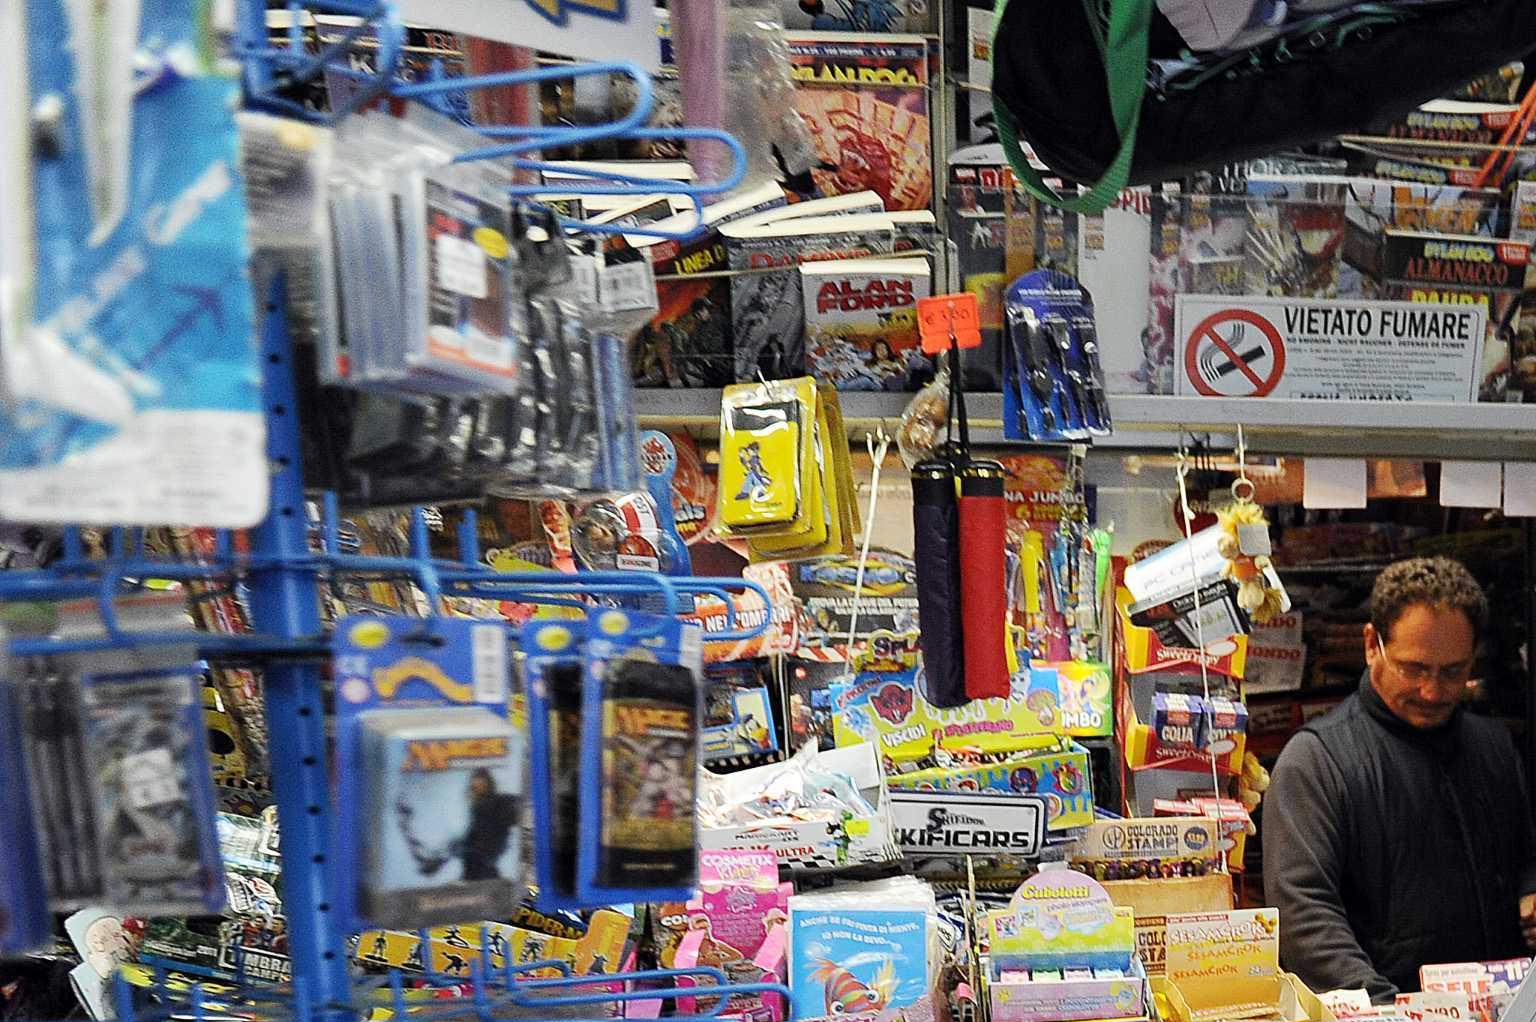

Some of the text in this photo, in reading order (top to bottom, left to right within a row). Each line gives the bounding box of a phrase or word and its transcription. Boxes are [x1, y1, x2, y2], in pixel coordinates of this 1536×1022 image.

[818, 279, 914, 298] ALAN
[815, 293, 916, 315] FORD
[1284, 305, 1472, 340] VIETATO FUMARE
[1161, 726, 1193, 742] GOLIA
[1126, 825, 1178, 838] COLORADO
[776, 846, 815, 858] ULTRA
